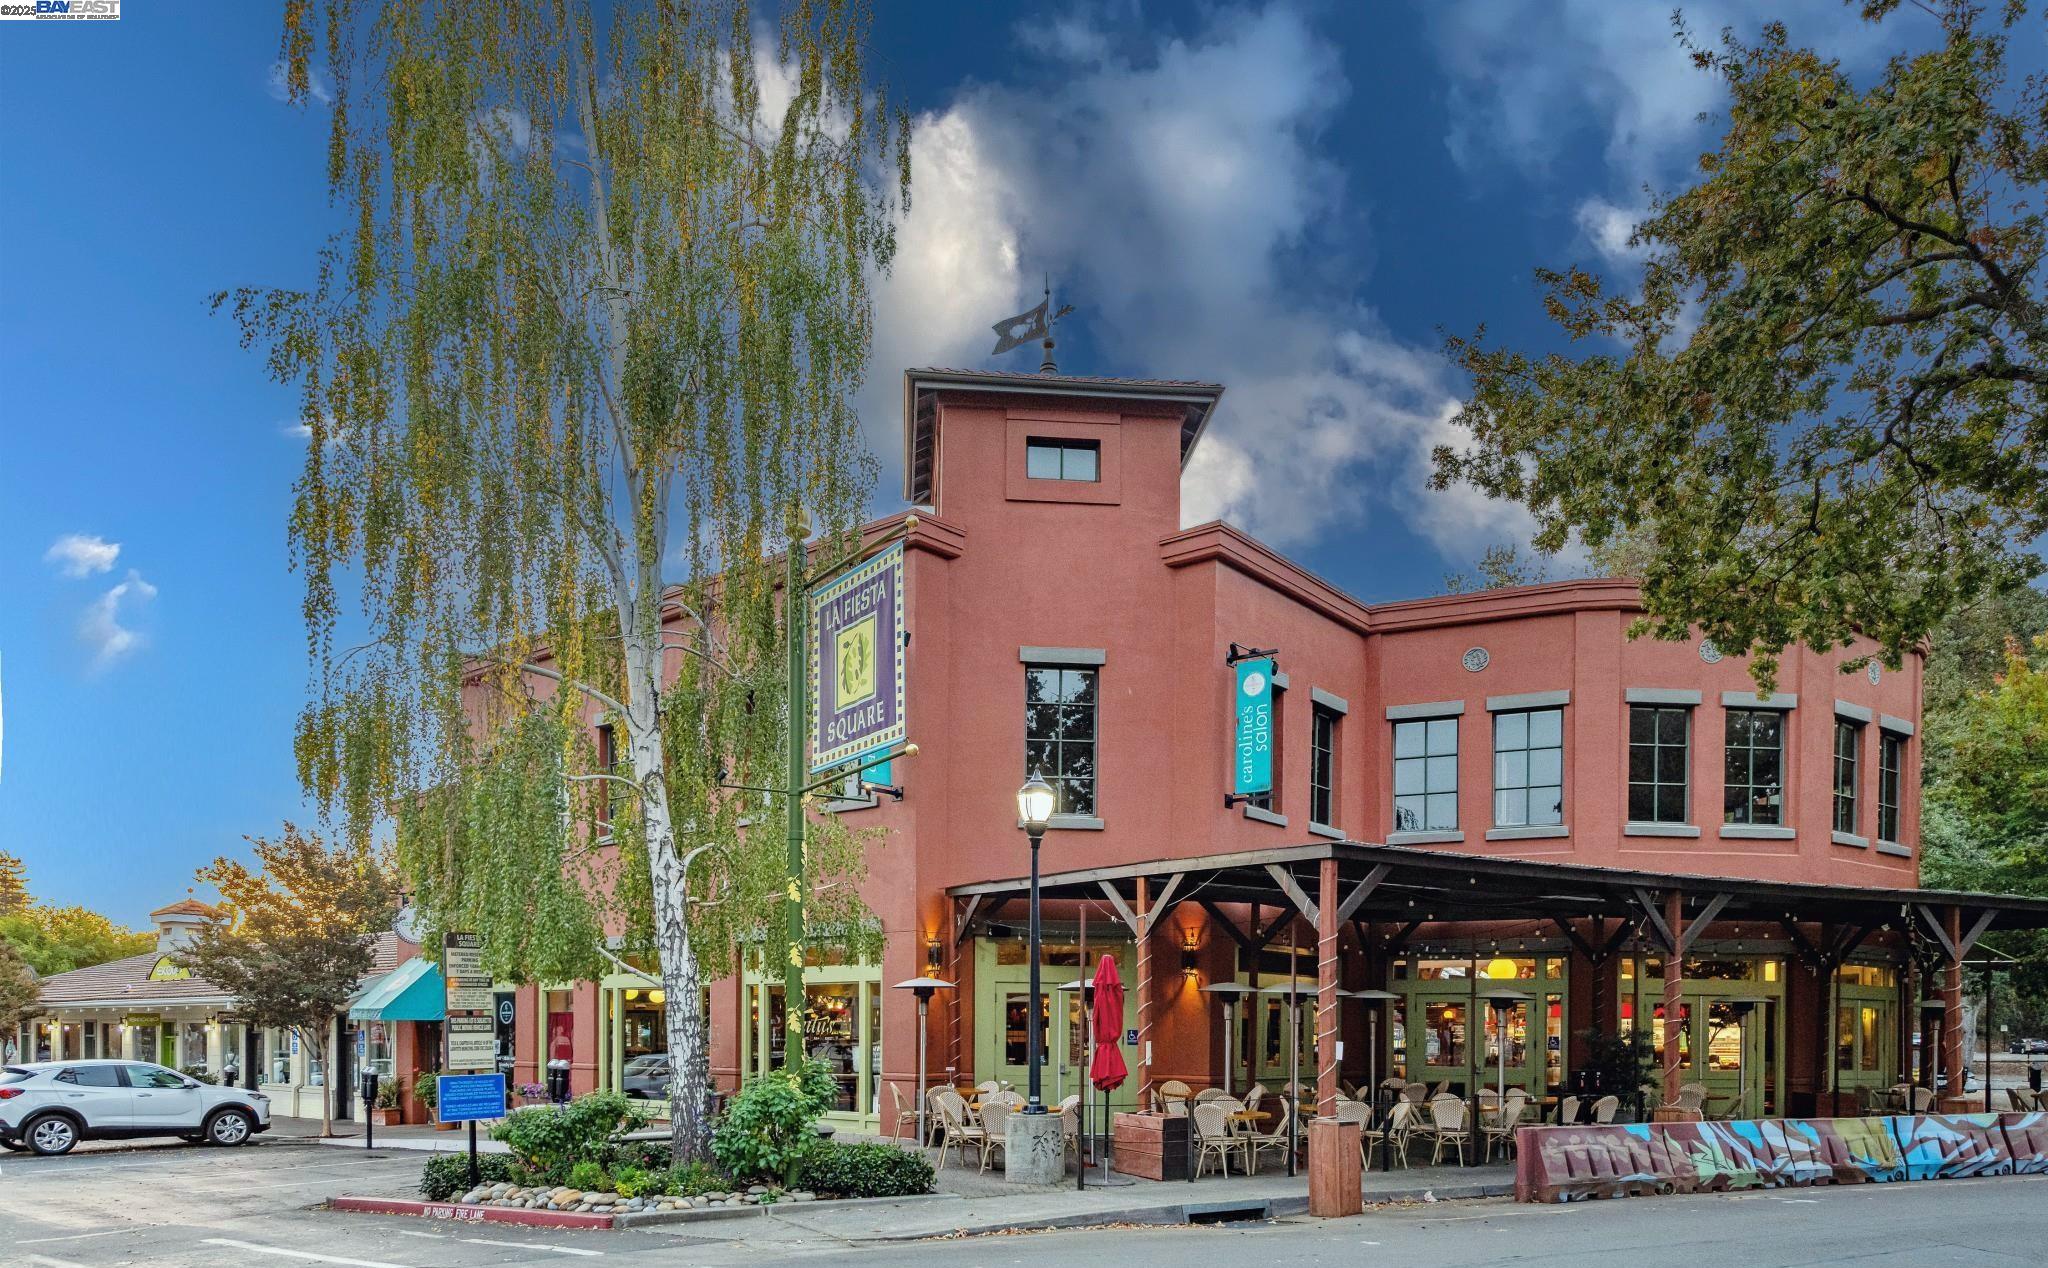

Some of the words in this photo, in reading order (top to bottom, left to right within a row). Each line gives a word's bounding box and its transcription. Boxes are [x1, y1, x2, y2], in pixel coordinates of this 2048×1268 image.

[825, 605, 841, 630] LA
[844, 580, 886, 621] FIESTA
[827, 700, 885, 743] SQUARE
[1239, 705, 1254, 783] caroline's
[1254, 703, 1267, 752] salon
[423, 1206, 431, 1216] NO
[432, 1207, 453, 1217] PARKING
[455, 1208, 468, 1219] FIRE
[469, 1209, 485, 1219] LANE
